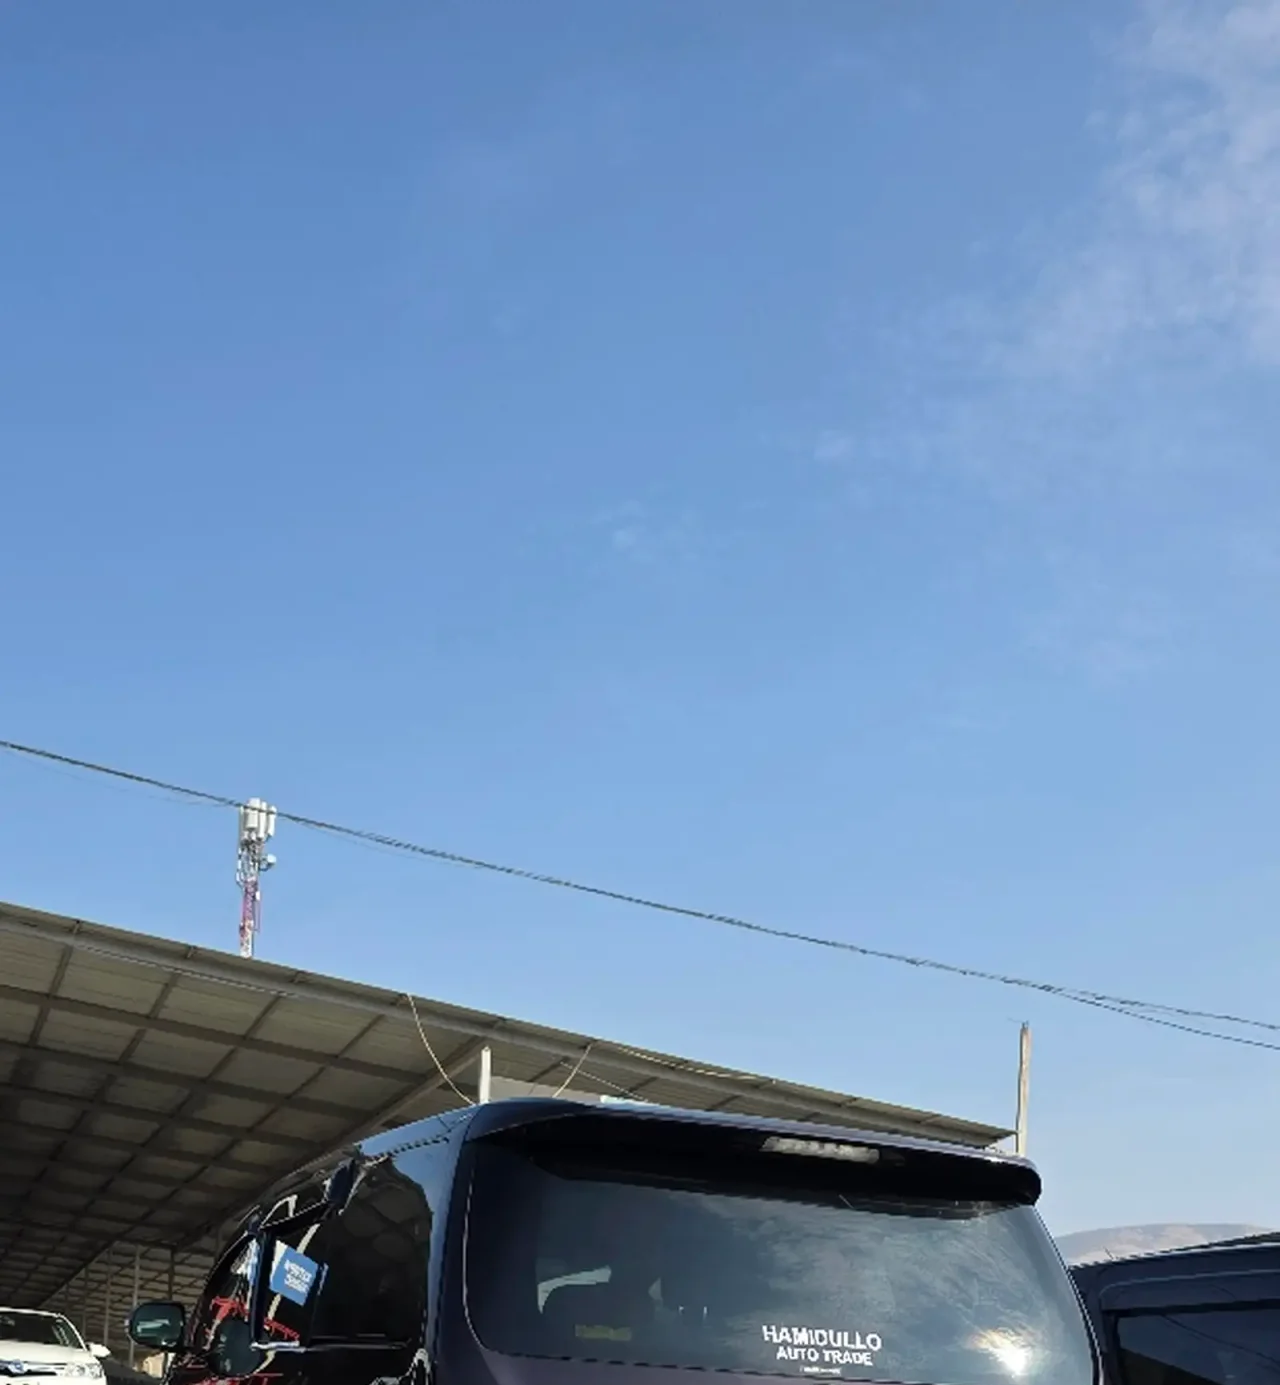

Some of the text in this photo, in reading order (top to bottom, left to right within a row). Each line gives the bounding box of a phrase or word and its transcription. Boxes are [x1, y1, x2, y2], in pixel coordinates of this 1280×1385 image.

[762, 1325, 882, 1351] HAMIDULLO
[776, 1346, 873, 1366] AUTO TRADE
